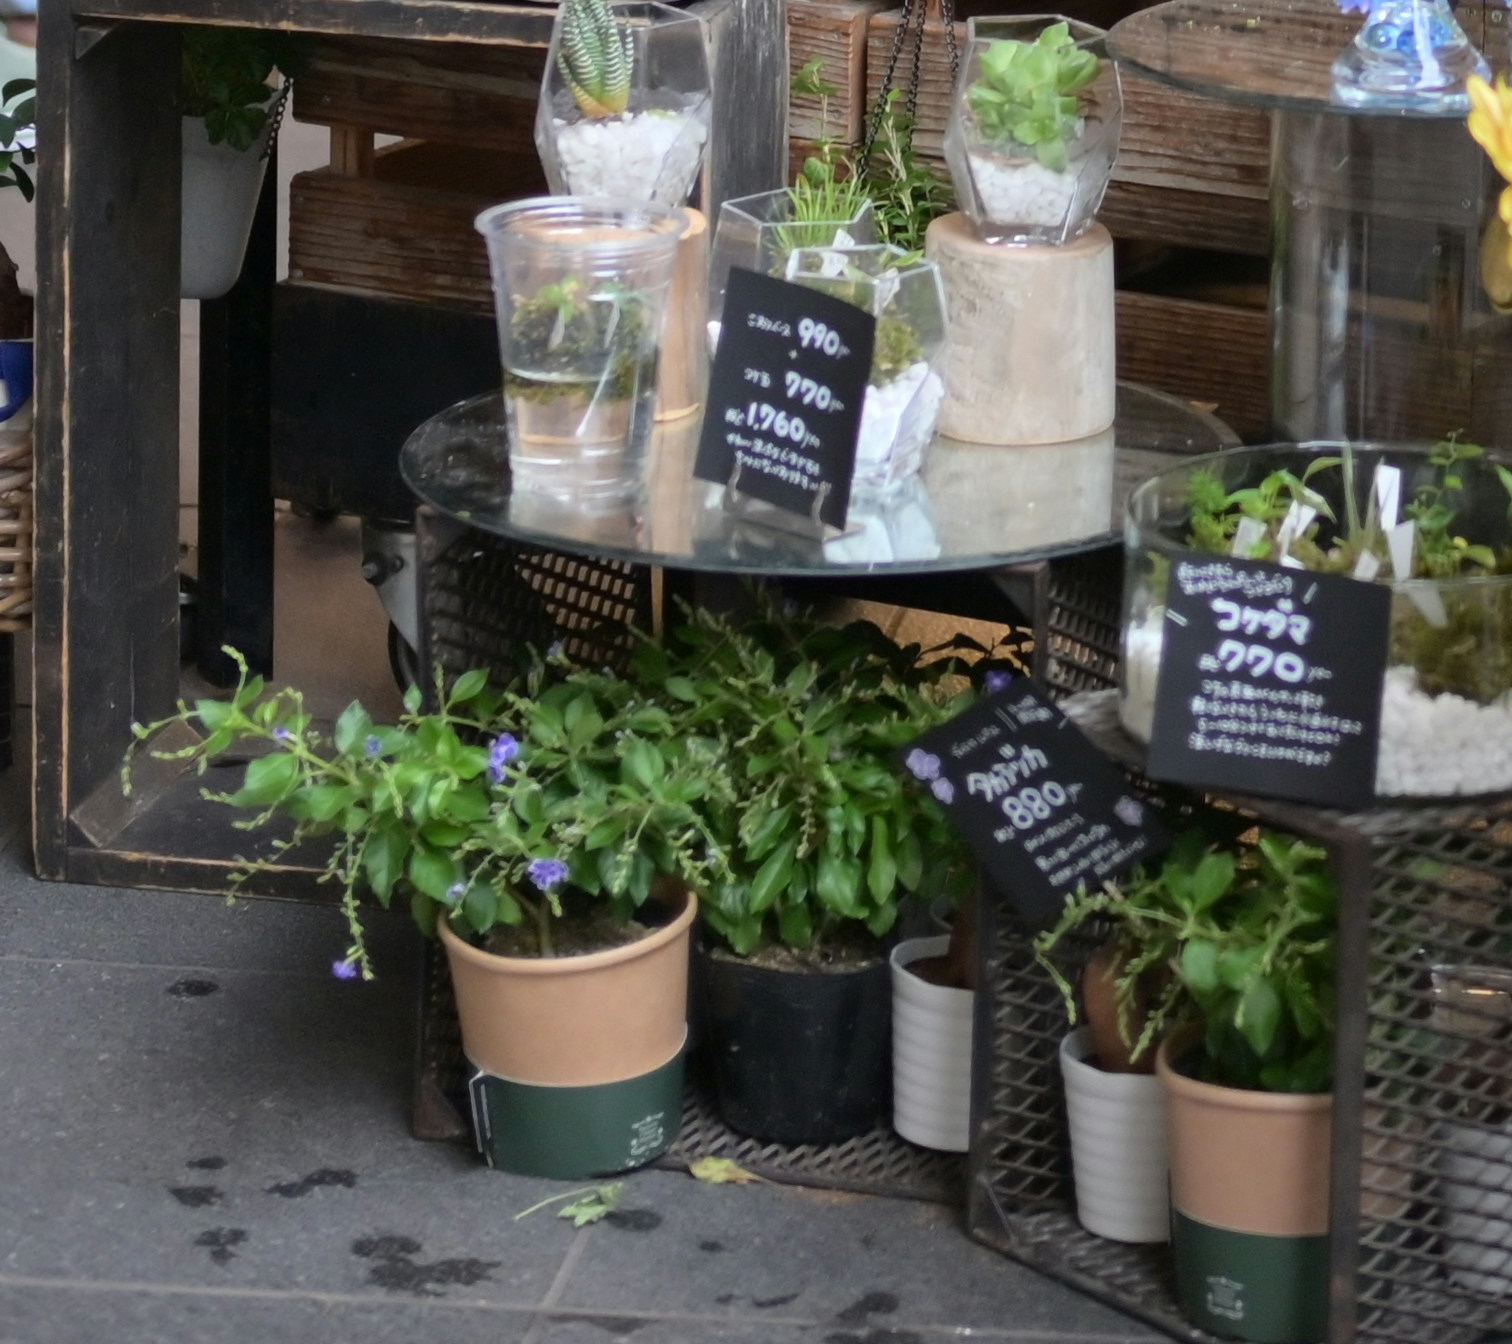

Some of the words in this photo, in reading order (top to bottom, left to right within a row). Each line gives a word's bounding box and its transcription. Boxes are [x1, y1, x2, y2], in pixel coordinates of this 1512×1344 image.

[797, 317, 841, 356] 990
[784, 370, 831, 410] 770
[1211, 596, 1311, 646] コケダマ
[1217, 638, 1305, 683] 770
[1001, 780, 1067, 830] 880
